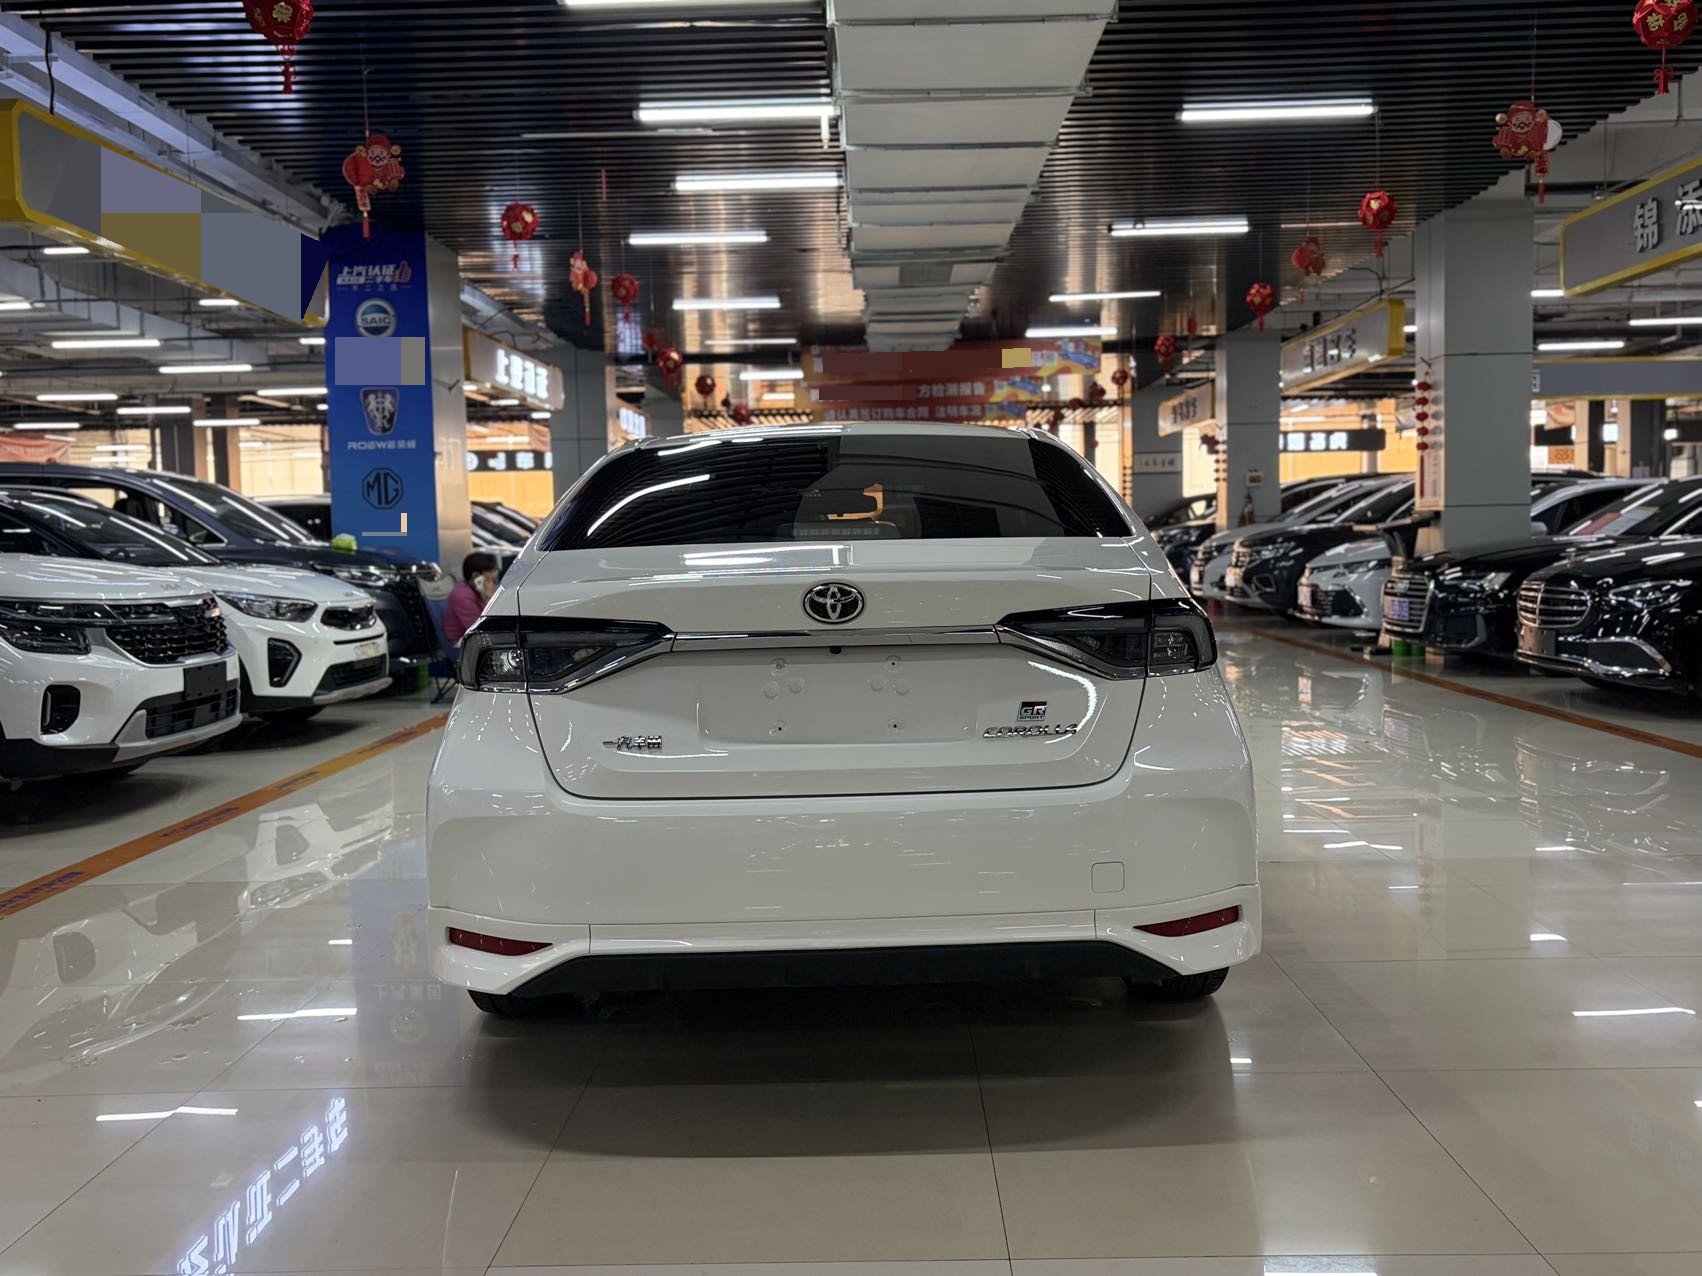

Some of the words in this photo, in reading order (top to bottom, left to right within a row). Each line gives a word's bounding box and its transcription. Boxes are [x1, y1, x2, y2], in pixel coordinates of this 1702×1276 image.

[361, 316, 392, 326] SAIC
[366, 471, 400, 506] MG
[1020, 705, 1048, 716] GR
[982, 723, 1078, 739] COROLLA
